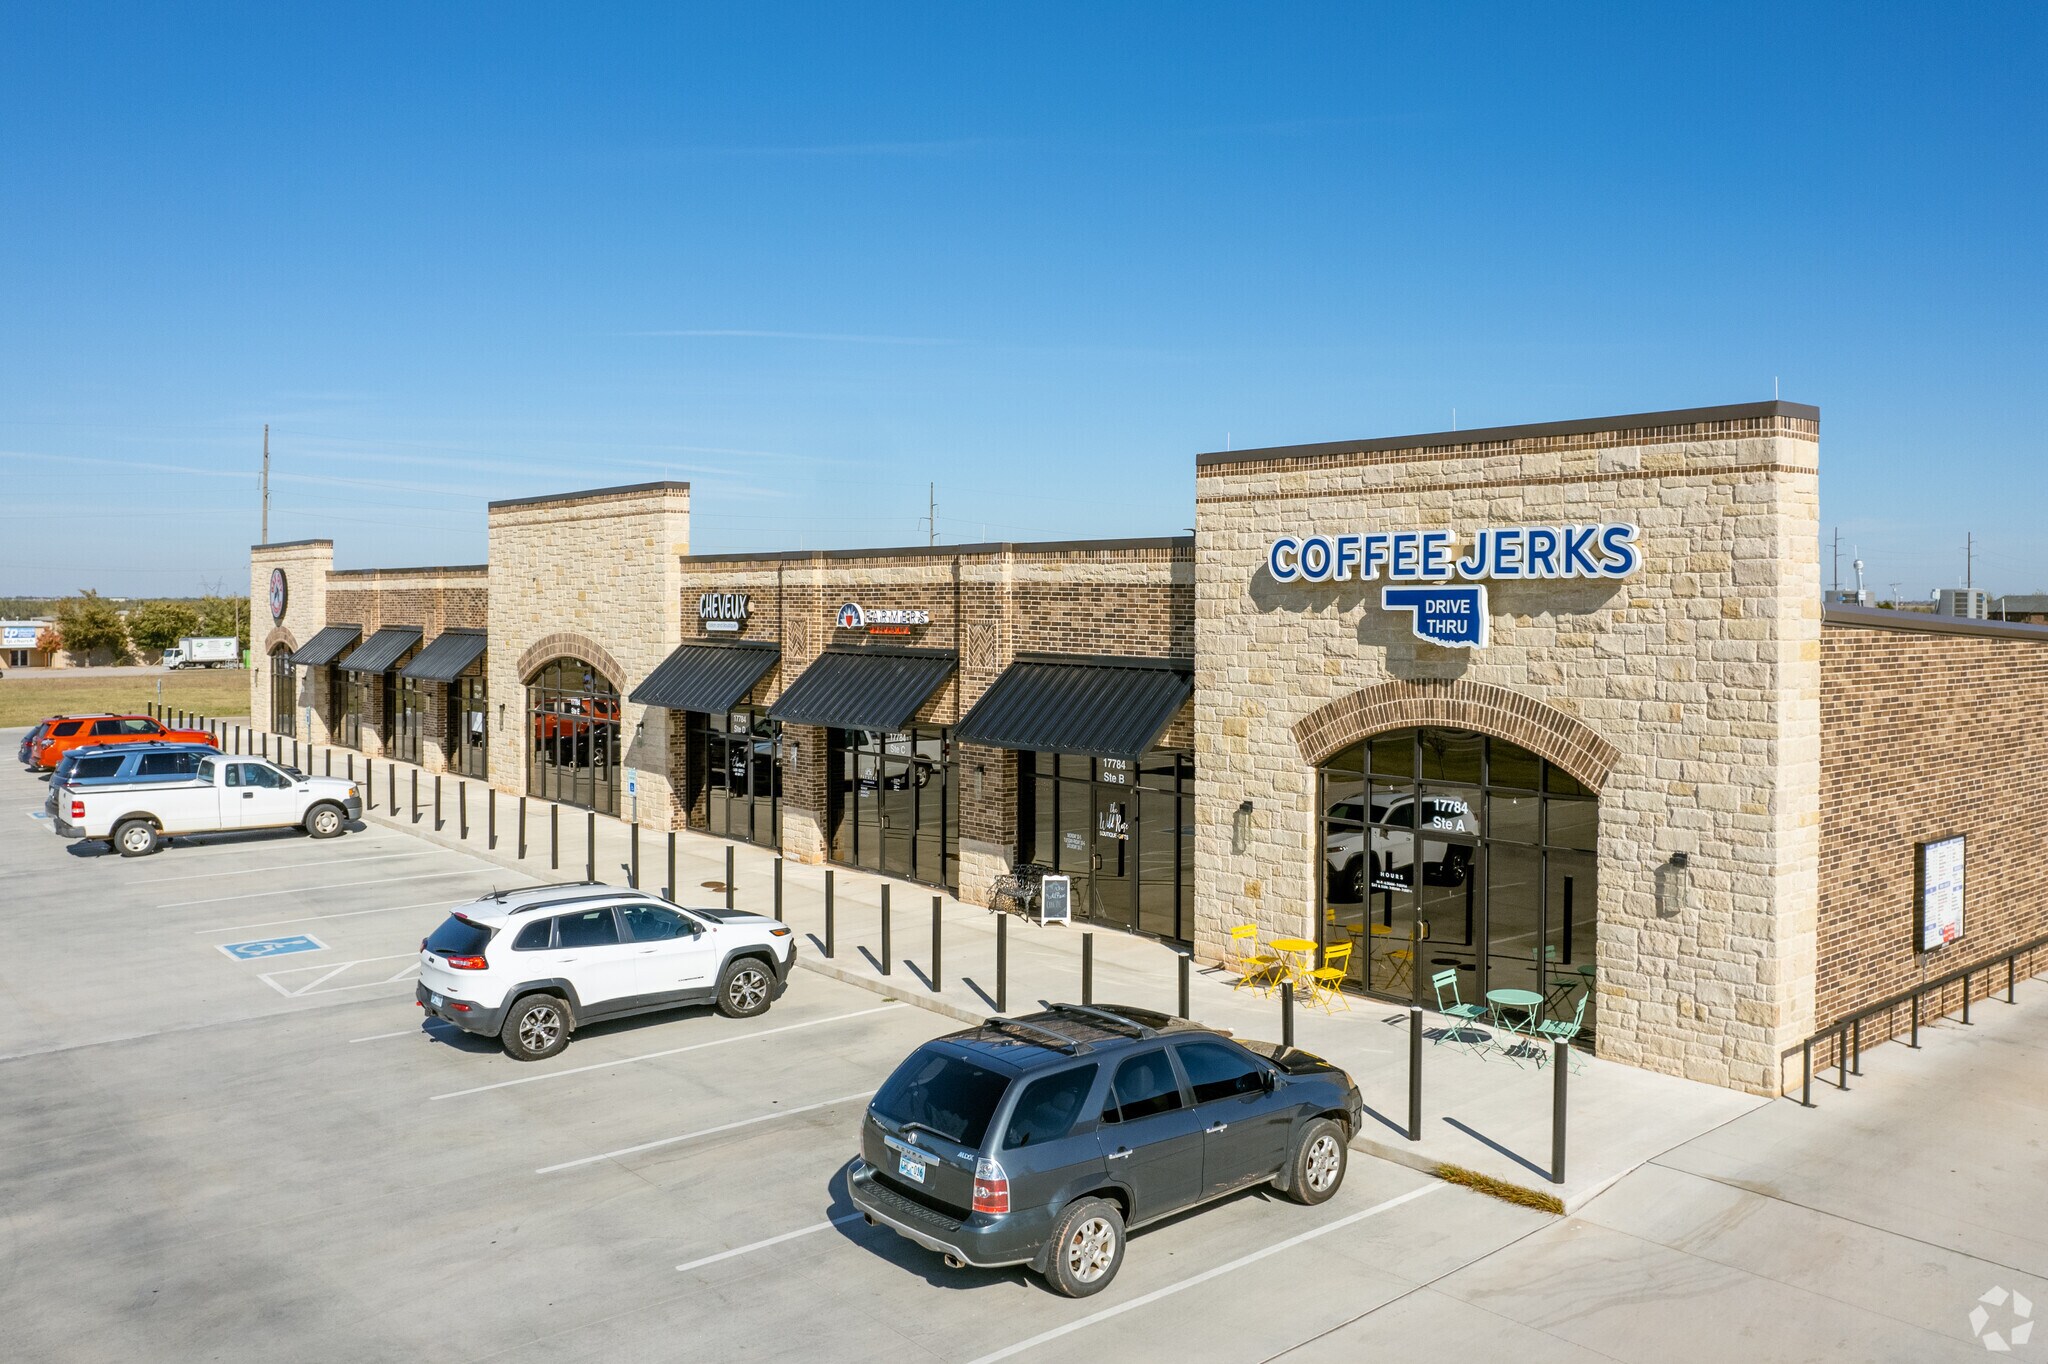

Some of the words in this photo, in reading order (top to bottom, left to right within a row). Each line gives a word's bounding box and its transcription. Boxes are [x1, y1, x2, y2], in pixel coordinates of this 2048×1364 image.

[1268, 529, 1456, 583] COFFEE
[1456, 522, 1642, 581] JERKS
[700, 593, 747, 619] CHEVEUX
[1425, 599, 1470, 615] DRIVE
[865, 609, 930, 624] FARMERS
[1426, 619, 1468, 634] THRU
[890, 744, 900, 754] Ste
[900, 745, 906, 754] C
[1103, 758, 1126, 770] 17784
[1103, 772, 1117, 784] Ste
[1118, 774, 1125, 784] B
[1433, 799, 1469, 815] 17784
[1432, 816, 1453, 830] Ste
[1455, 819, 1465, 832] A
[1380, 871, 1404, 880] HOURS
[896, 1144, 923, 1159] ACURA
